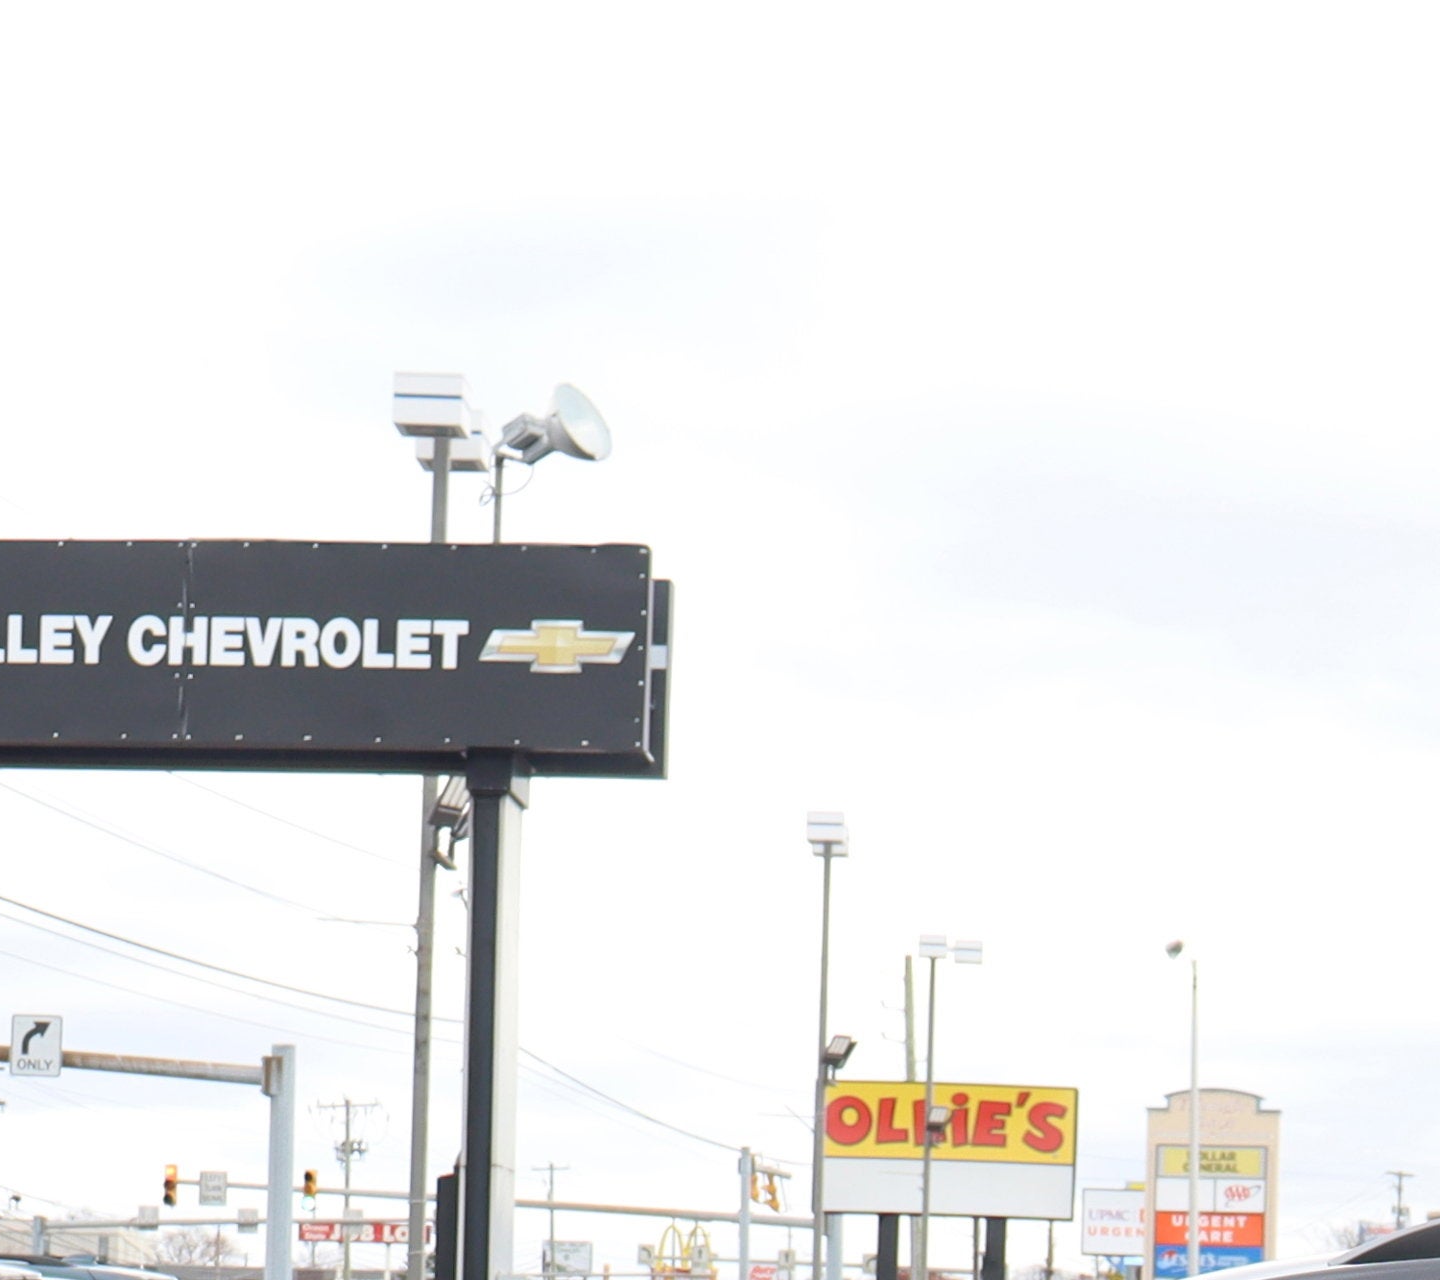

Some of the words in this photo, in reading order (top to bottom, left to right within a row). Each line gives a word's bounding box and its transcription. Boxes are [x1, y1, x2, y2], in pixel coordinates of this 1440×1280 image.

[126, 614, 469, 670] CHEVROLET
[16, 1057, 53, 1072] ONLY
[1187, 1150, 1237, 1161] OLLAR
[1182, 1161, 1239, 1174] GNERAL
[1088, 1207, 1131, 1221] UPMC
[382, 1223, 409, 1242] LO
[1088, 1225, 1147, 1238] URGEN
